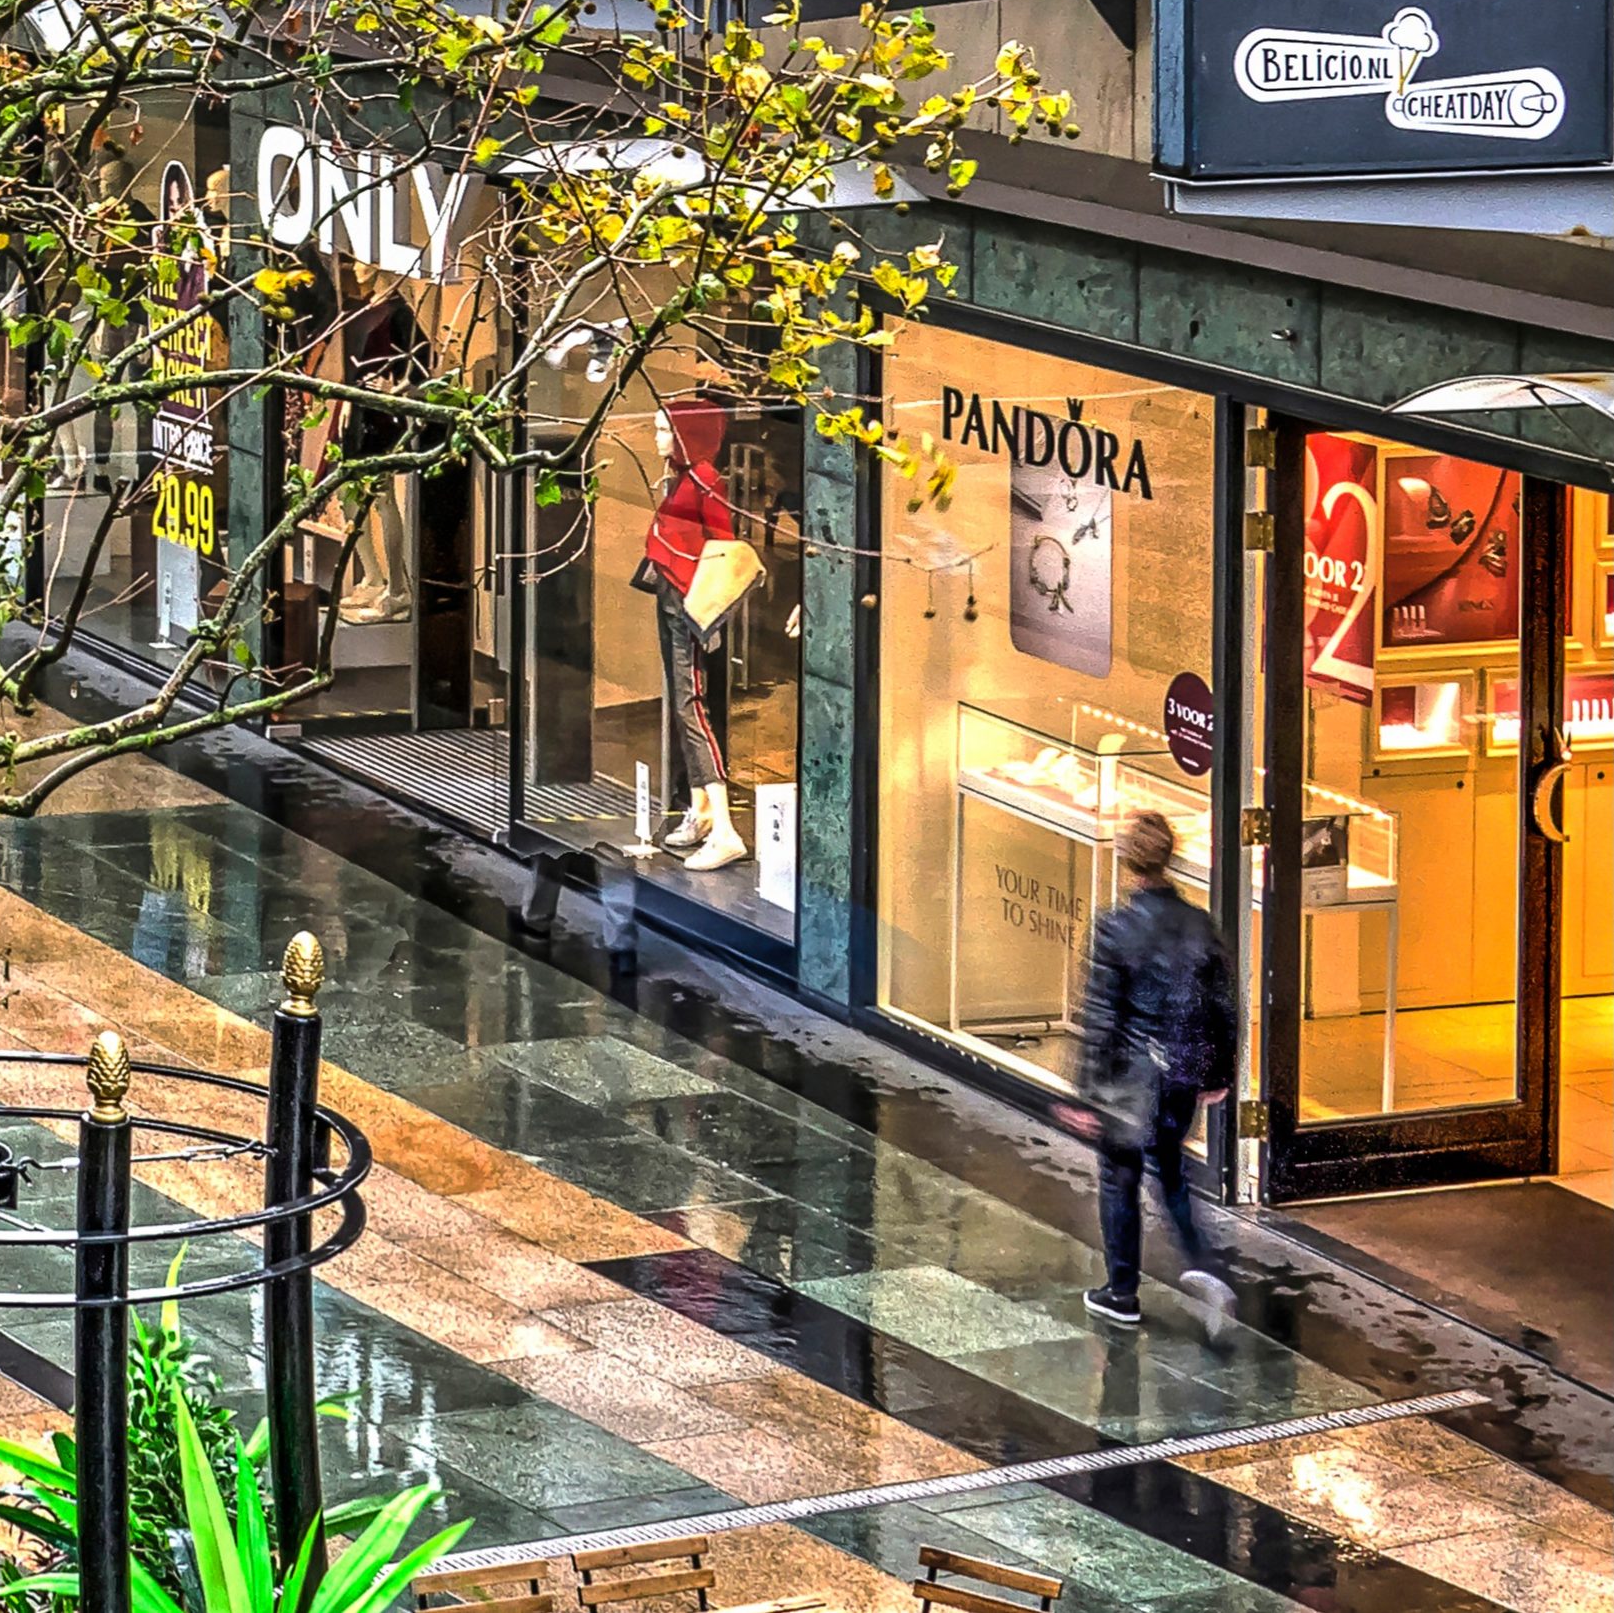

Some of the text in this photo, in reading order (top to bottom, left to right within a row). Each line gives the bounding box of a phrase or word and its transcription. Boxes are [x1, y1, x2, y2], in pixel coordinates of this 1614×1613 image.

[1407, 88, 1508, 120] CHEATDAY
[258, 125, 470, 285] ONLY
[942, 385, 1154, 501] PANDORA
[1304, 551, 1347, 587] OOR
[1167, 697, 1175, 716] 3
[994, 863, 1084, 923] YOUR TIME
[1001, 897, 1076, 950] TO SHINE
